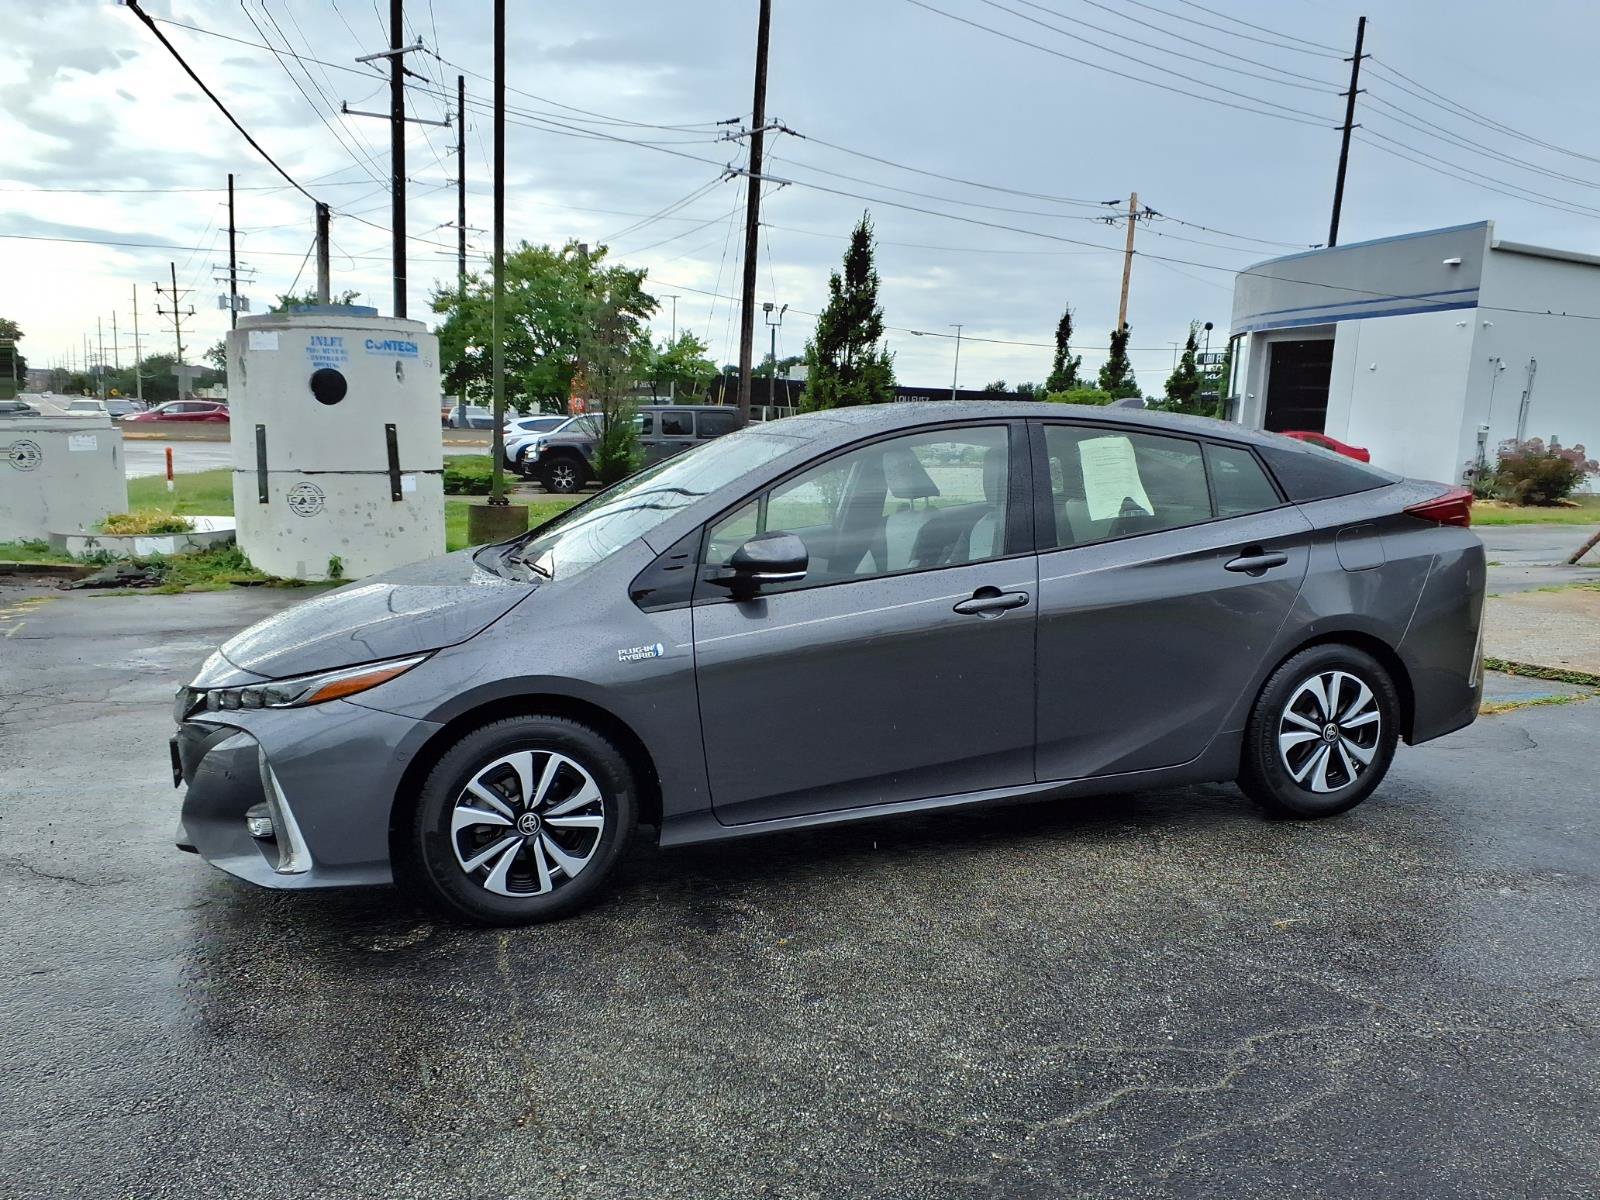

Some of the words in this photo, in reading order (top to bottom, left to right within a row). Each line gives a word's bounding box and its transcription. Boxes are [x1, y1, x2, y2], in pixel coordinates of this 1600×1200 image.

[310, 335, 344, 347] INLET
[365, 339, 417, 353] CONTECH
[617, 644, 654, 655] PLUG-IN
[618, 651, 654, 662] HYBRID
